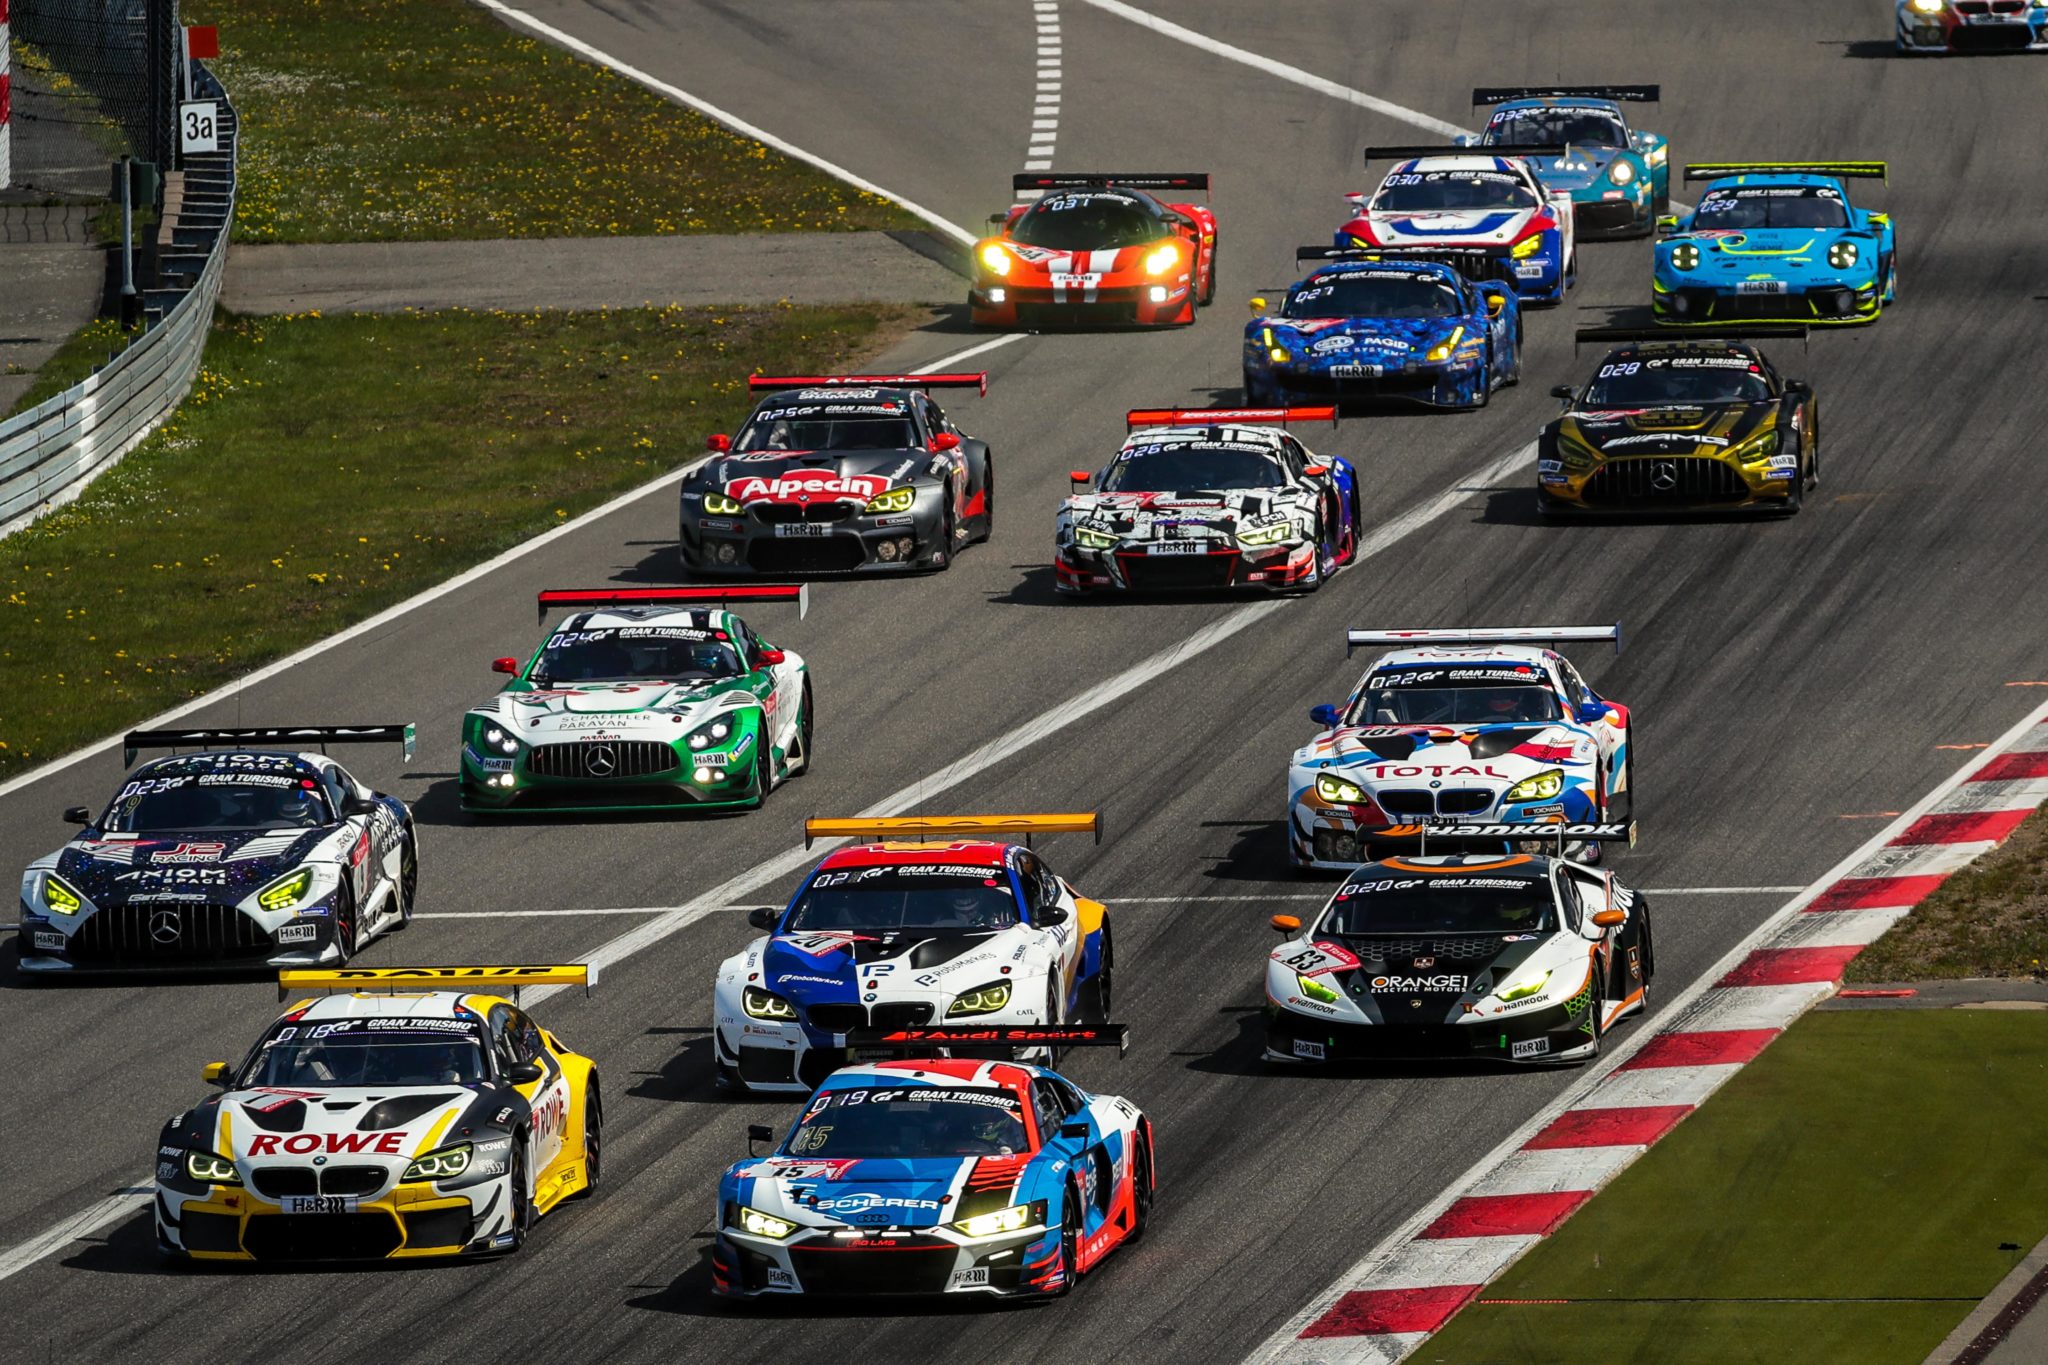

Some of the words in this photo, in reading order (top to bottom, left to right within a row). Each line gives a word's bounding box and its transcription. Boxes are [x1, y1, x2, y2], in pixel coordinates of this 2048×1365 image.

[186, 112, 213, 140] 3a
[1385, 174, 1422, 187] 030
[1449, 172, 1476, 180] GRAN
[1052, 199, 1089, 211] 031
[1364, 337, 1409, 349] PAGID
[1672, 358, 1701, 366] GRAN
[1704, 358, 1750, 367] TURISMO
[1335, 366, 1360, 378] H&R
[1597, 361, 1641, 378] 028
[825, 405, 854, 413] GRAN
[1642, 433, 1730, 446] AMG
[1119, 444, 1163, 460] 026
[1191, 441, 1222, 449] GRAN
[1223, 442, 1271, 452] TURISMO
[740, 478, 874, 500] Alpecin
[1088, 518, 1110, 530] PCH
[1263, 512, 1286, 524] PCH
[783, 525, 808, 536] H&R
[1156, 542, 1182, 553] H&R
[619, 628, 653, 636] GRAN
[655, 628, 706, 639] TURISMO
[547, 632, 594, 649] 024
[1449, 669, 1484, 678] GRAN
[1486, 669, 1541, 680] TURISMO
[561, 713, 651, 722] SCHAEFFLER
[558, 720, 628, 730] PARAVAN
[161, 754, 289, 768] AXIOM
[484, 758, 501, 768] H&R
[694, 755, 714, 764] H&R
[215, 762, 285, 770] SPACE
[1366, 765, 1509, 779] TOTAL
[198, 774, 235, 784] GRAN
[236, 774, 293, 786] TURISMO
[122, 778, 170, 797] 023
[123, 795, 143, 816] 9
[1533, 806, 1562, 815] YOKOHAMA
[154, 842, 226, 857] J2
[152, 854, 219, 863] RACING
[114, 868, 226, 880] AXIOM
[898, 866, 937, 874] GRAN
[938, 866, 997, 877] TURISMO
[163, 877, 226, 885] SPACE
[1429, 878, 1467, 887] GRAN
[1469, 878, 1526, 888] TURISMO
[1342, 879, 1394, 896] 020
[36, 932, 54, 944] H&R
[280, 928, 302, 939] H&R
[789, 934, 833, 948] 20
[1286, 950, 1327, 971] 63
[1329, 947, 1352, 962] TOTAL
[934, 951, 997, 978] RoboMarkets
[790, 974, 844, 986] RoboMarkets
[1371, 975, 1469, 989] ORANGE1
[367, 1018, 410, 1028] GRAN
[411, 1018, 473, 1030] TURISMO
[925, 1030, 999, 1040] Audi
[1006, 1030, 1097, 1041] Sport
[1514, 1042, 1535, 1056] H&R
[909, 1090, 952, 1100] GRAN
[953, 1091, 1016, 1107] TURISMO
[798, 1125, 834, 1150] 15
[248, 1132, 409, 1157] ROWE
[478, 1140, 508, 1153] ROWE
[159, 1145, 183, 1157] ROWE
[772, 1165, 805, 1178] 15
[293, 1197, 325, 1213] H&R
[816, 1197, 938, 1211] SCHERER
[769, 1271, 788, 1282] H&R
[953, 1269, 974, 1283] H&R
